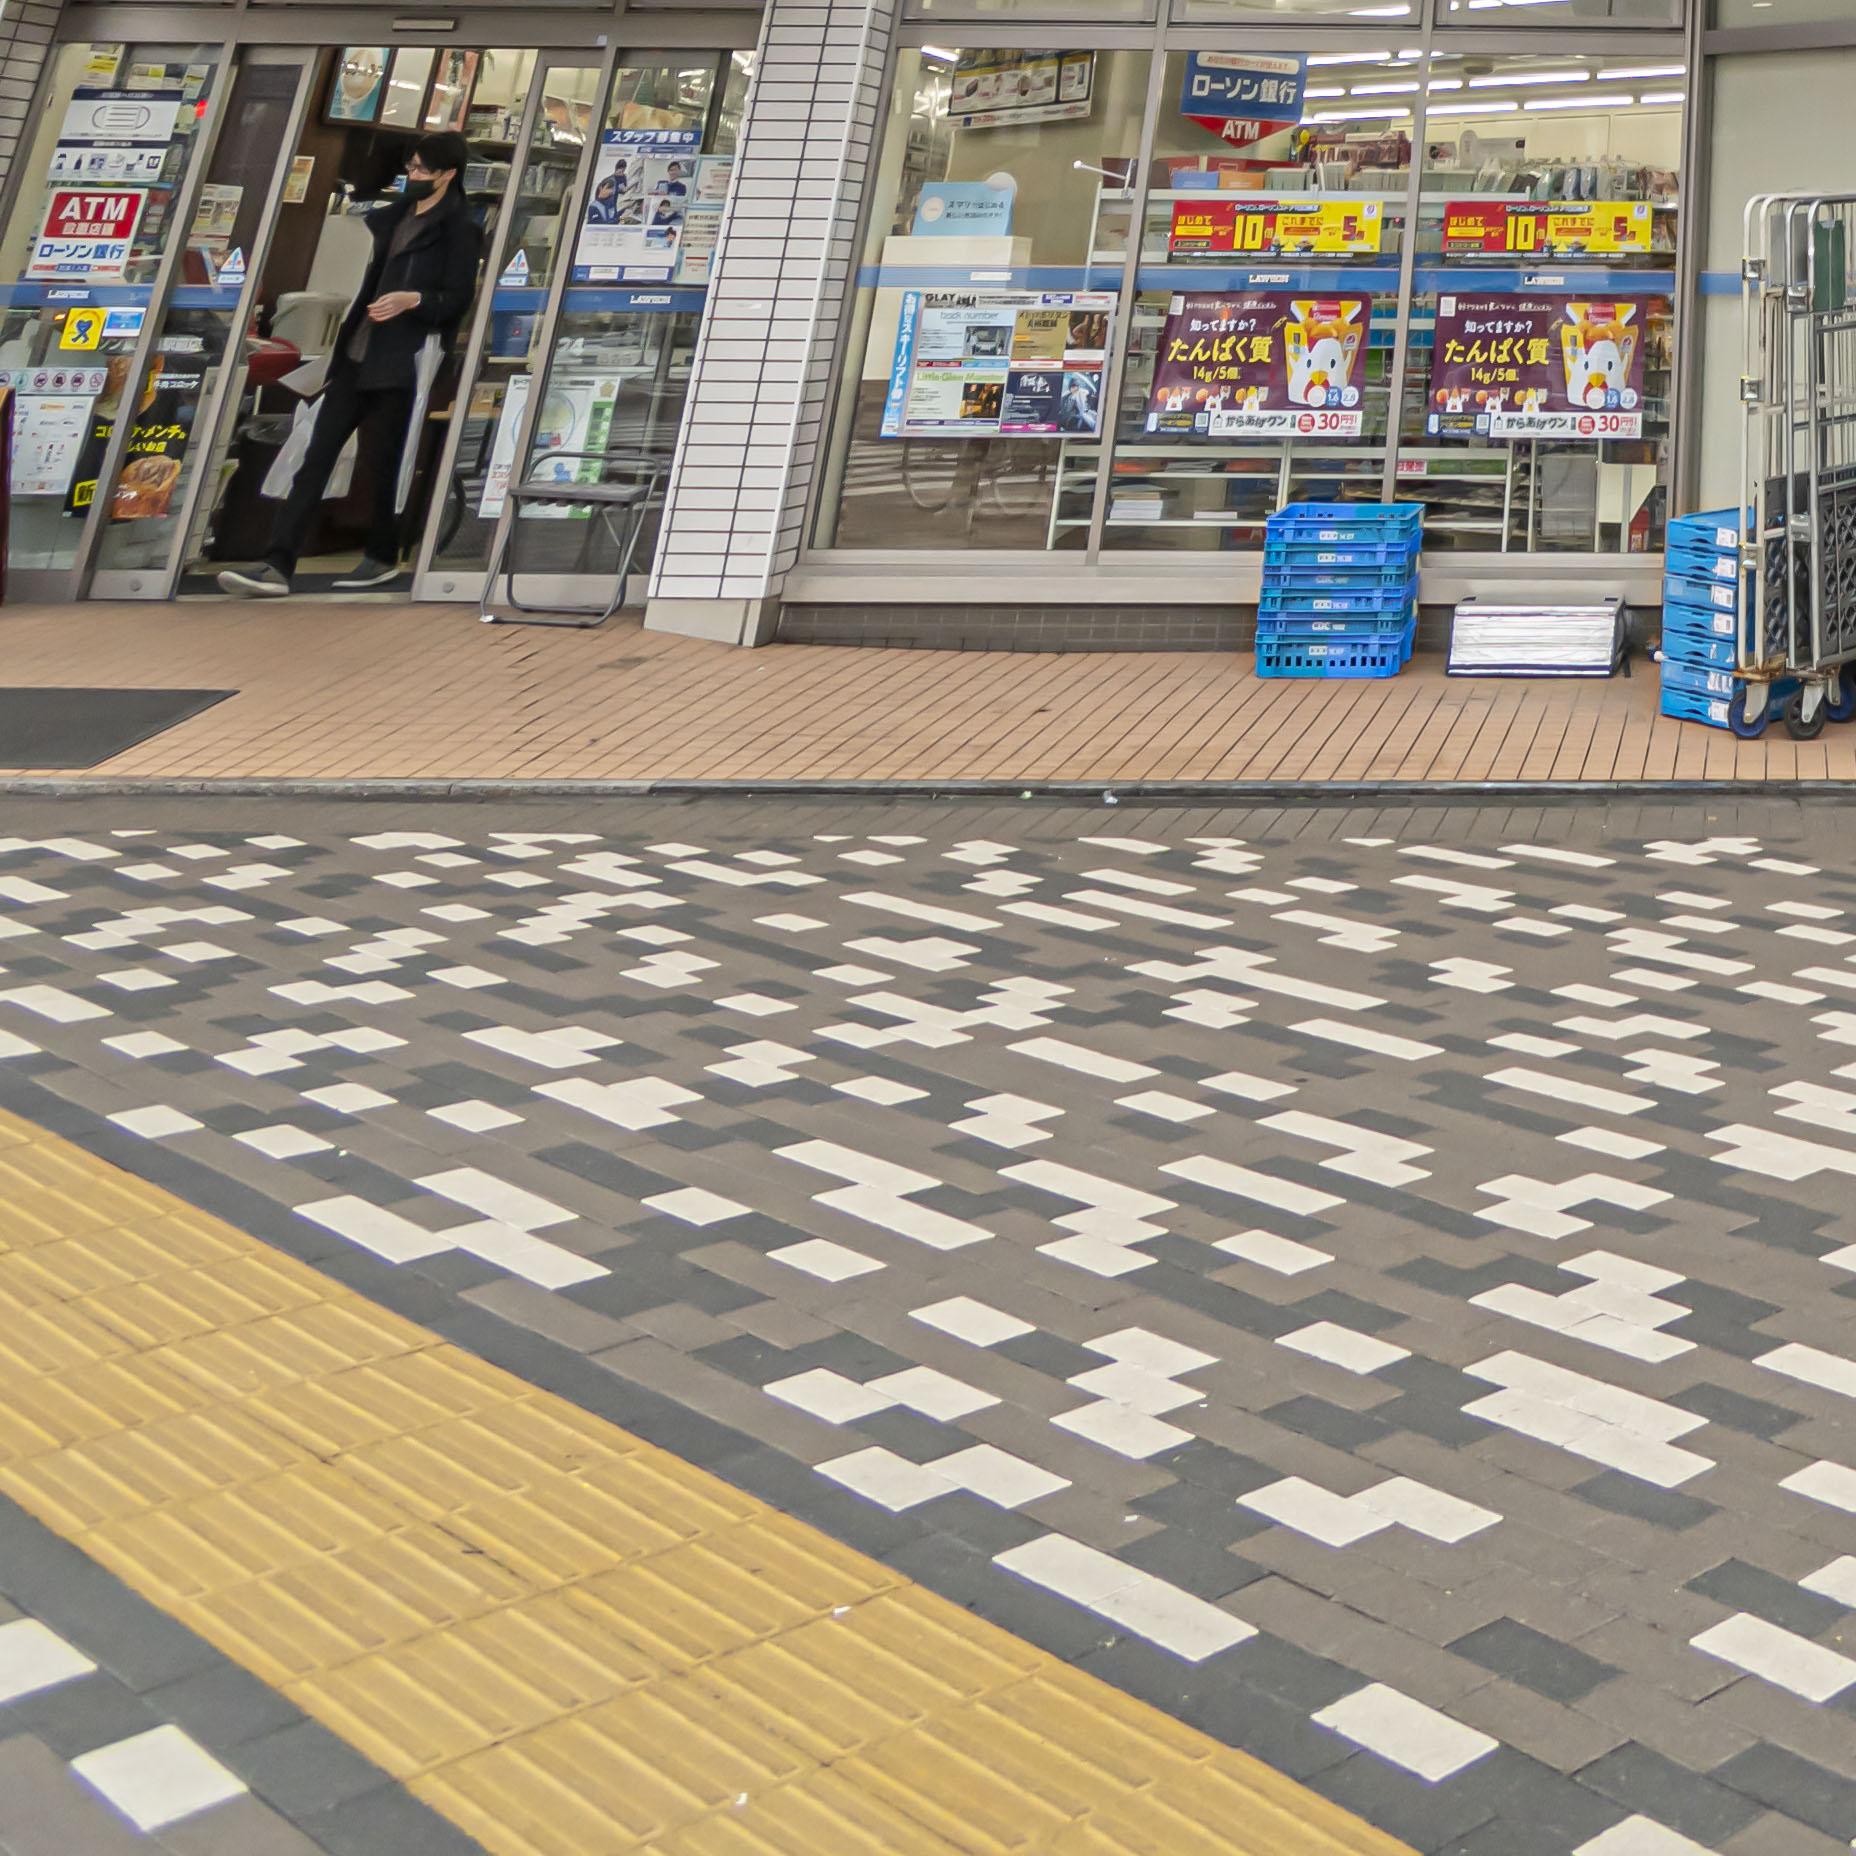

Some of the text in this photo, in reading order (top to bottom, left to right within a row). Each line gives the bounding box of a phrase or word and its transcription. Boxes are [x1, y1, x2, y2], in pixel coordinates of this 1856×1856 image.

[1192, 74, 1297, 104] ローソン銀行
[1221, 119, 1260, 140] ATM
[58, 197, 129, 221] ATM
[1168, 335, 1273, 363] たんぱく質
[1444, 337, 1550, 365] たんぱく質
